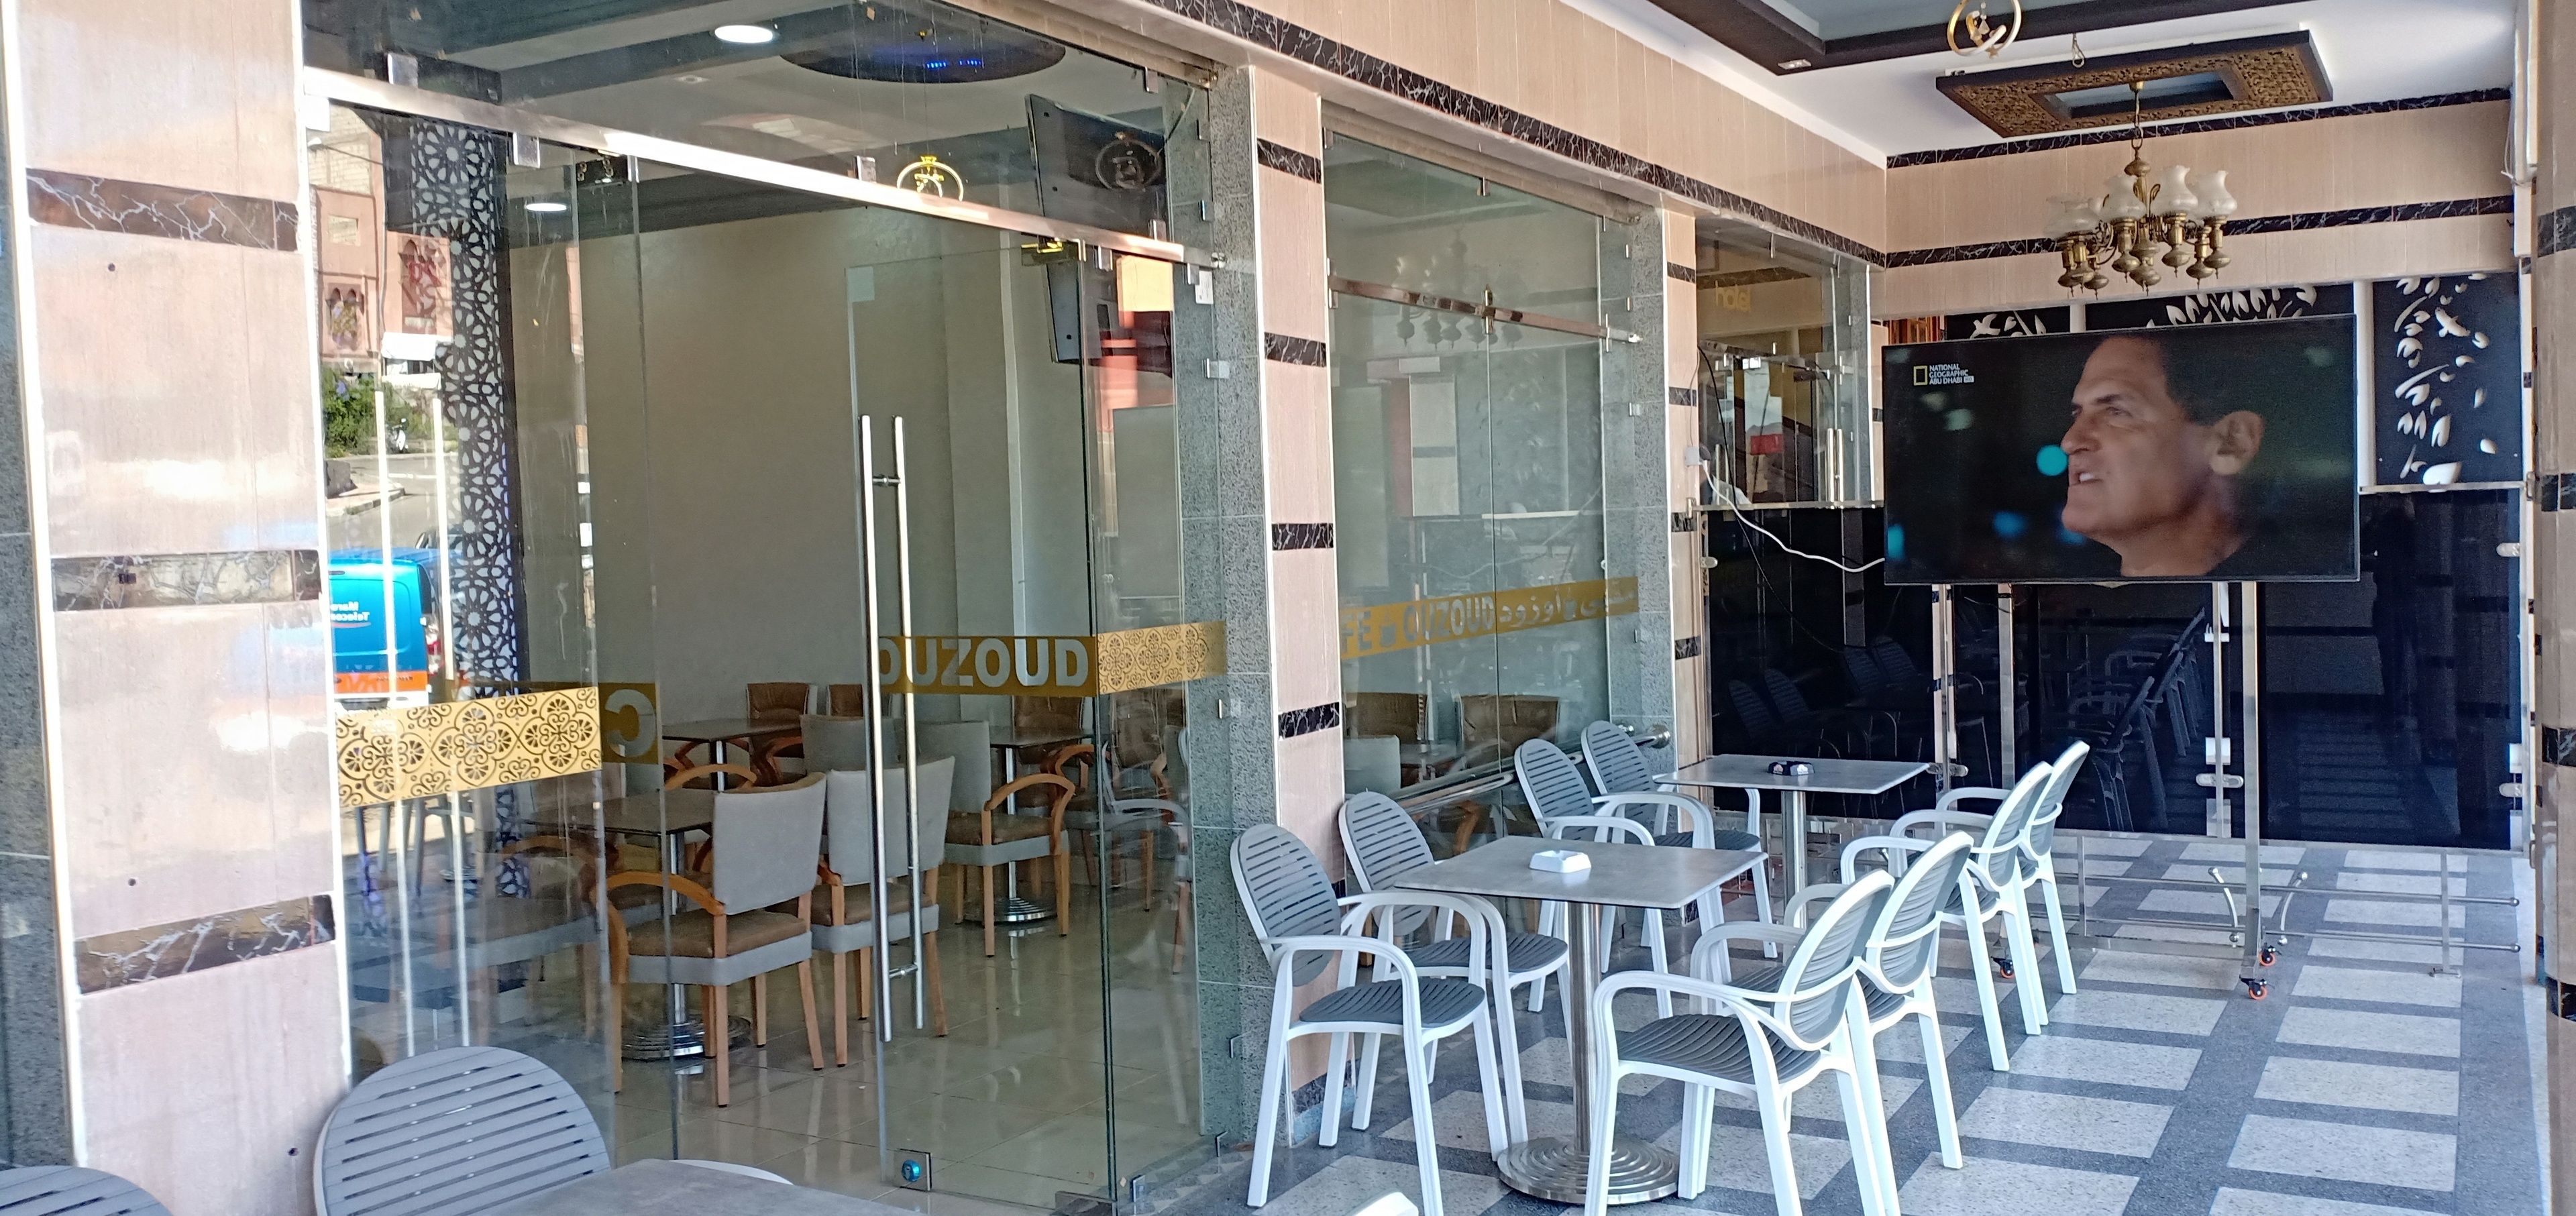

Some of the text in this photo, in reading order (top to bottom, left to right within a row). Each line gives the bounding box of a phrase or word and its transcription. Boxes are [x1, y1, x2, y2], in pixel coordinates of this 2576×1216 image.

[1929, 364, 1960, 372] NATIONAL
[1929, 369, 1969, 378] GEOGRAPHIC
[1929, 377, 1942, 385] ABU
[1943, 376, 1963, 384] DHABI
[1403, 595, 1495, 642] OUZOUD
[879, 638, 1089, 687] OUZOUD
